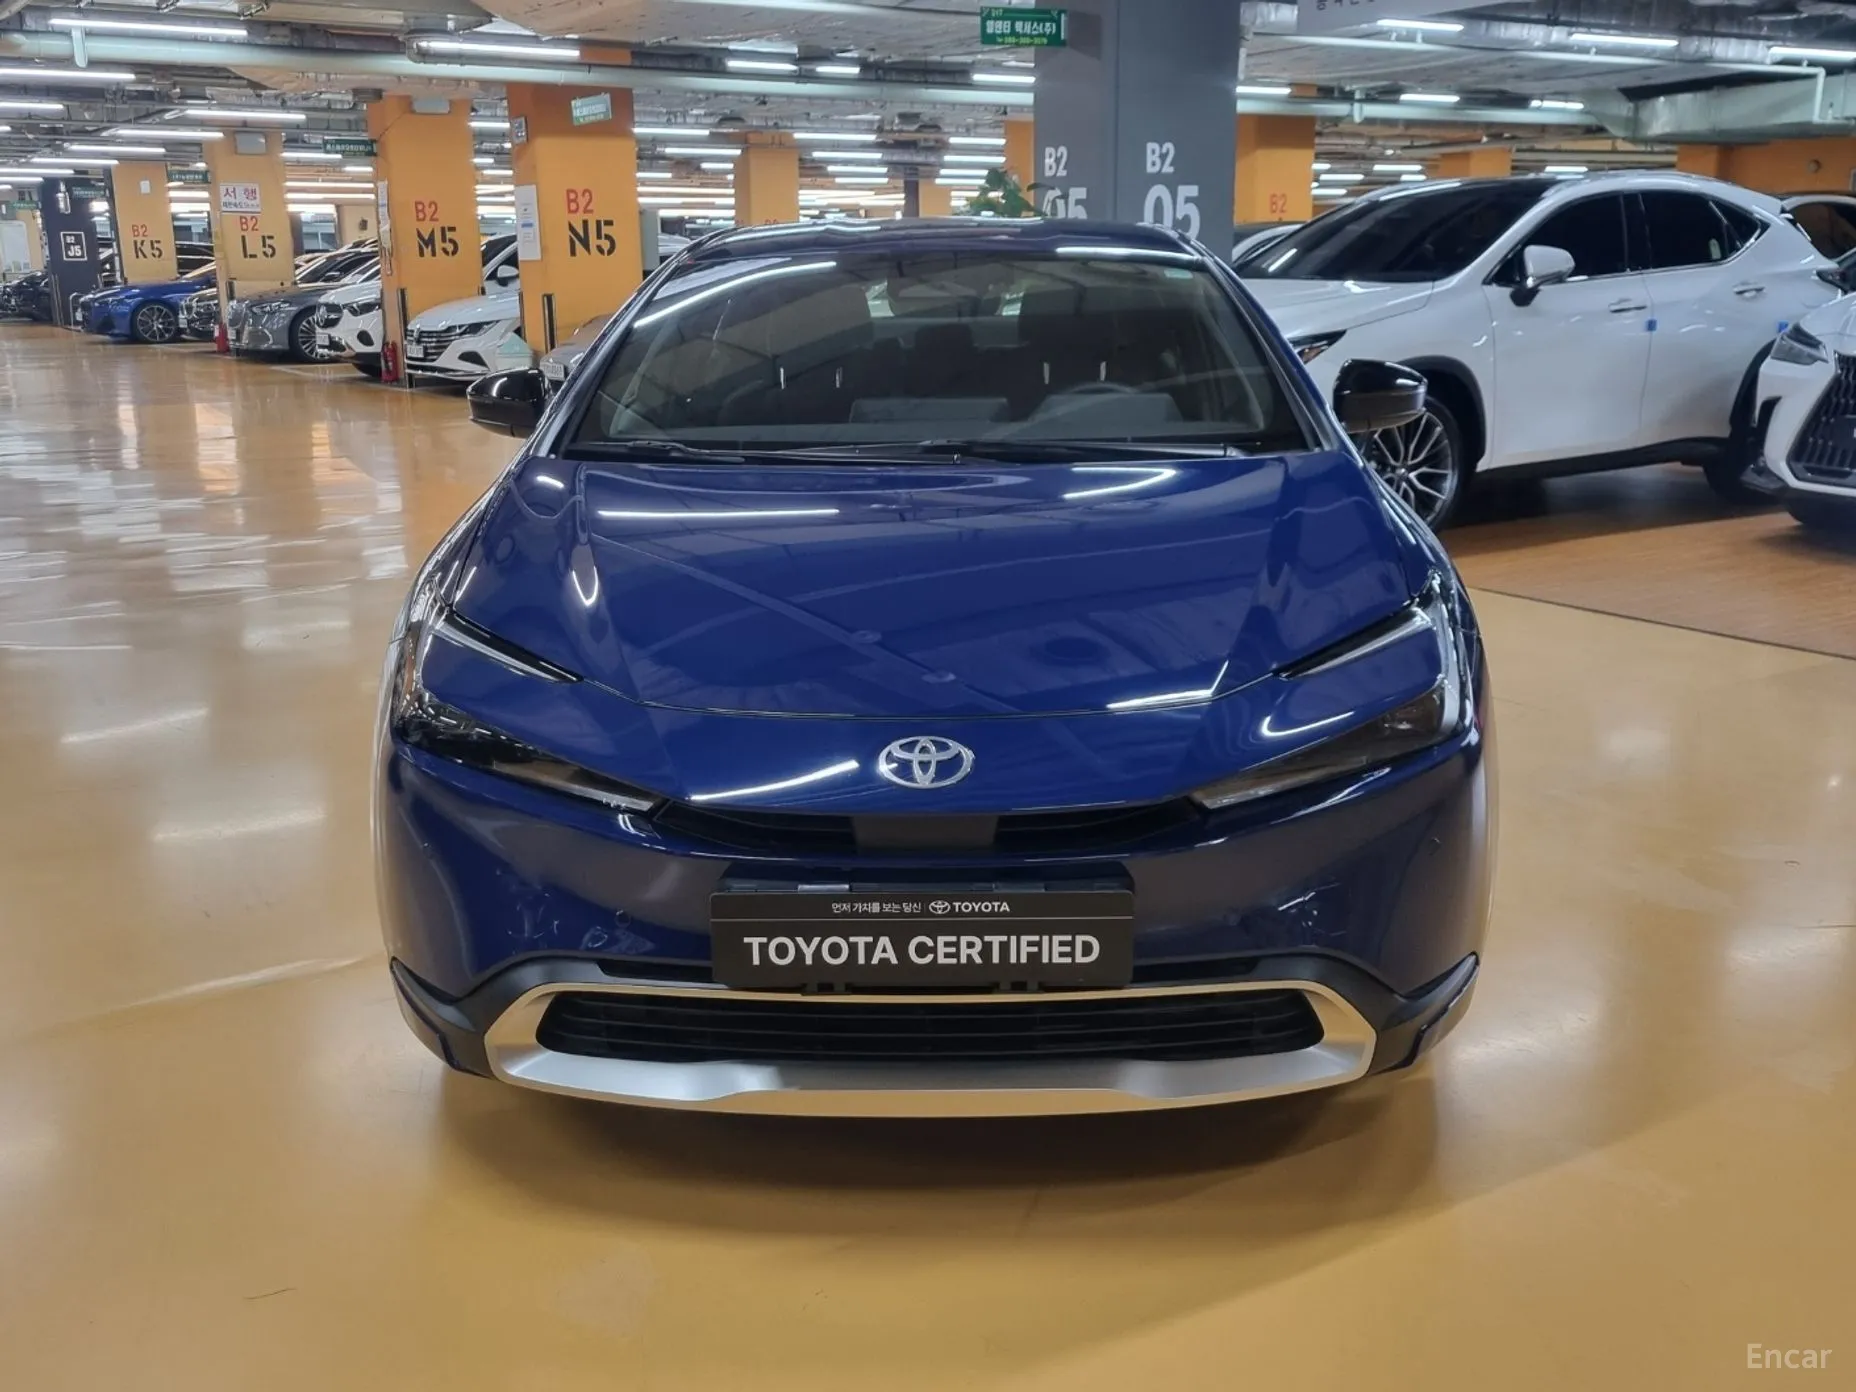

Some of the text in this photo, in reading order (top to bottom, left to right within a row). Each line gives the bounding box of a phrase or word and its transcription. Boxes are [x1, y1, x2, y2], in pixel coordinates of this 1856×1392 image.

[1044, 146, 1068, 177] B2
[1145, 142, 1175, 173] B2
[414, 201, 439, 222] B2
[566, 189, 594, 215] B2
[1269, 193, 1288, 214] B2
[131, 224, 148, 237] B2
[240, 216, 259, 232] B2
[133, 240, 163, 259] K5
[241, 235, 276, 258] L5
[416, 226, 459, 257] M5
[568, 220, 617, 257] N5
[68, 245, 82, 257] J5
[831, 901, 1010, 913] 먼저 가치를 보는 당신 TOYOTA
[743, 935, 1100, 965] TOYOTA CERTIFIED
